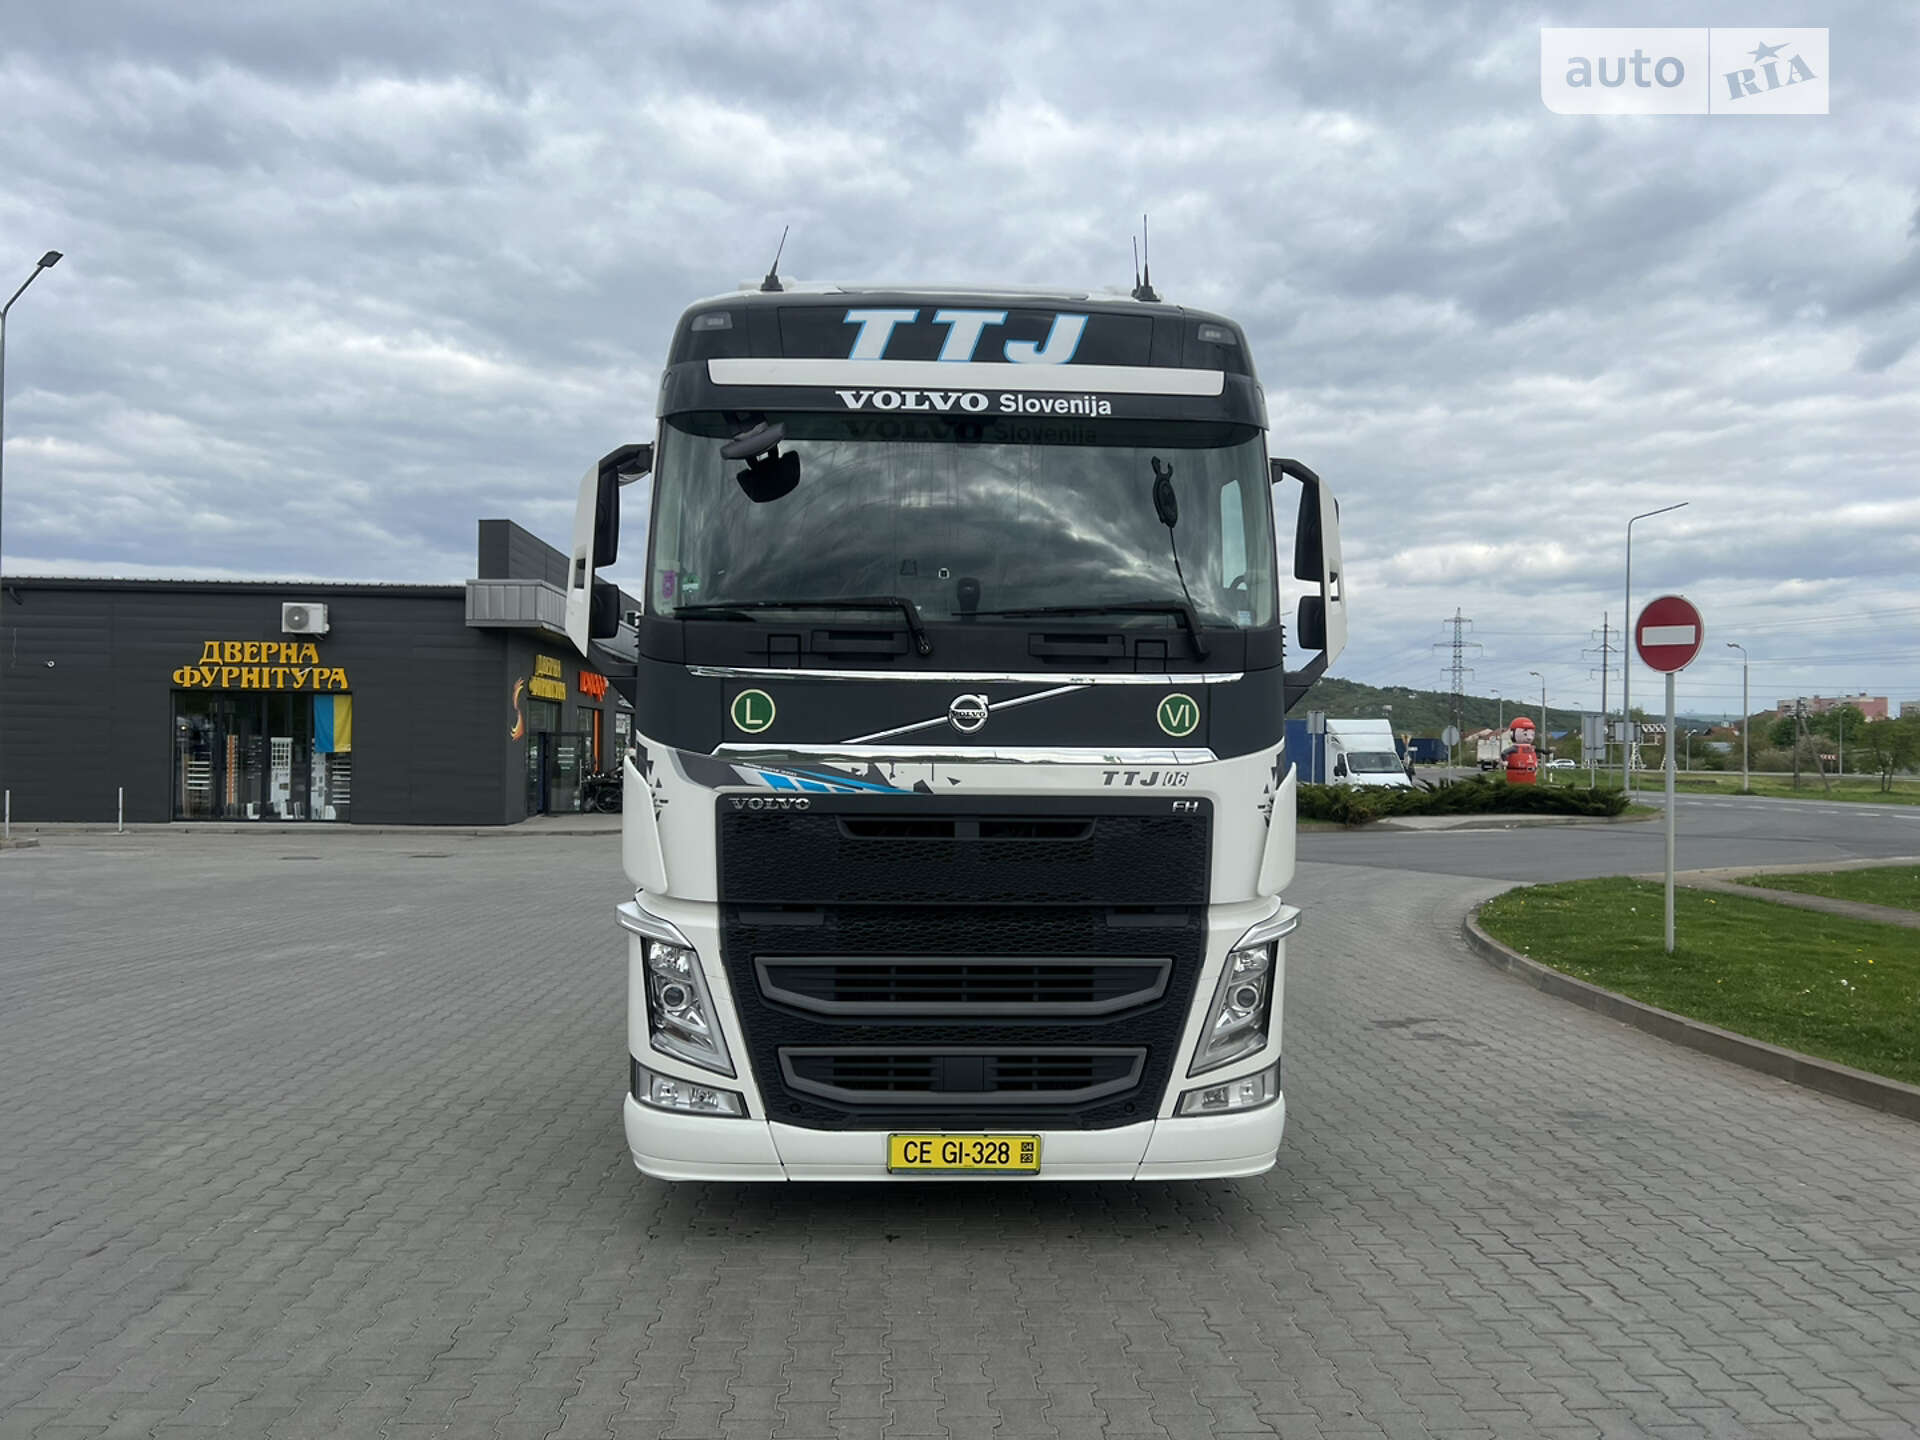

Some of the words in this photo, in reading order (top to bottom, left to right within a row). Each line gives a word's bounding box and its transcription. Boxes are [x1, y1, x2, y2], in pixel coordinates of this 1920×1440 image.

[843, 309, 1089, 364] TTJ
[835, 391, 989, 412] VOLVO
[1000, 394, 1112, 417] Slovenija
[198, 641, 319, 665] ДВЕРНА
[172, 665, 348, 689] ФУРНІТУРА
[746, 698, 763, 724] L
[1165, 704, 1190, 727] VI
[1102, 771, 1160, 786] TTJ
[728, 797, 811, 810] VOLVO
[1172, 801, 1199, 813] FH
[903, 1140, 933, 1164] CE
[942, 1141, 1010, 1164] GI-328
